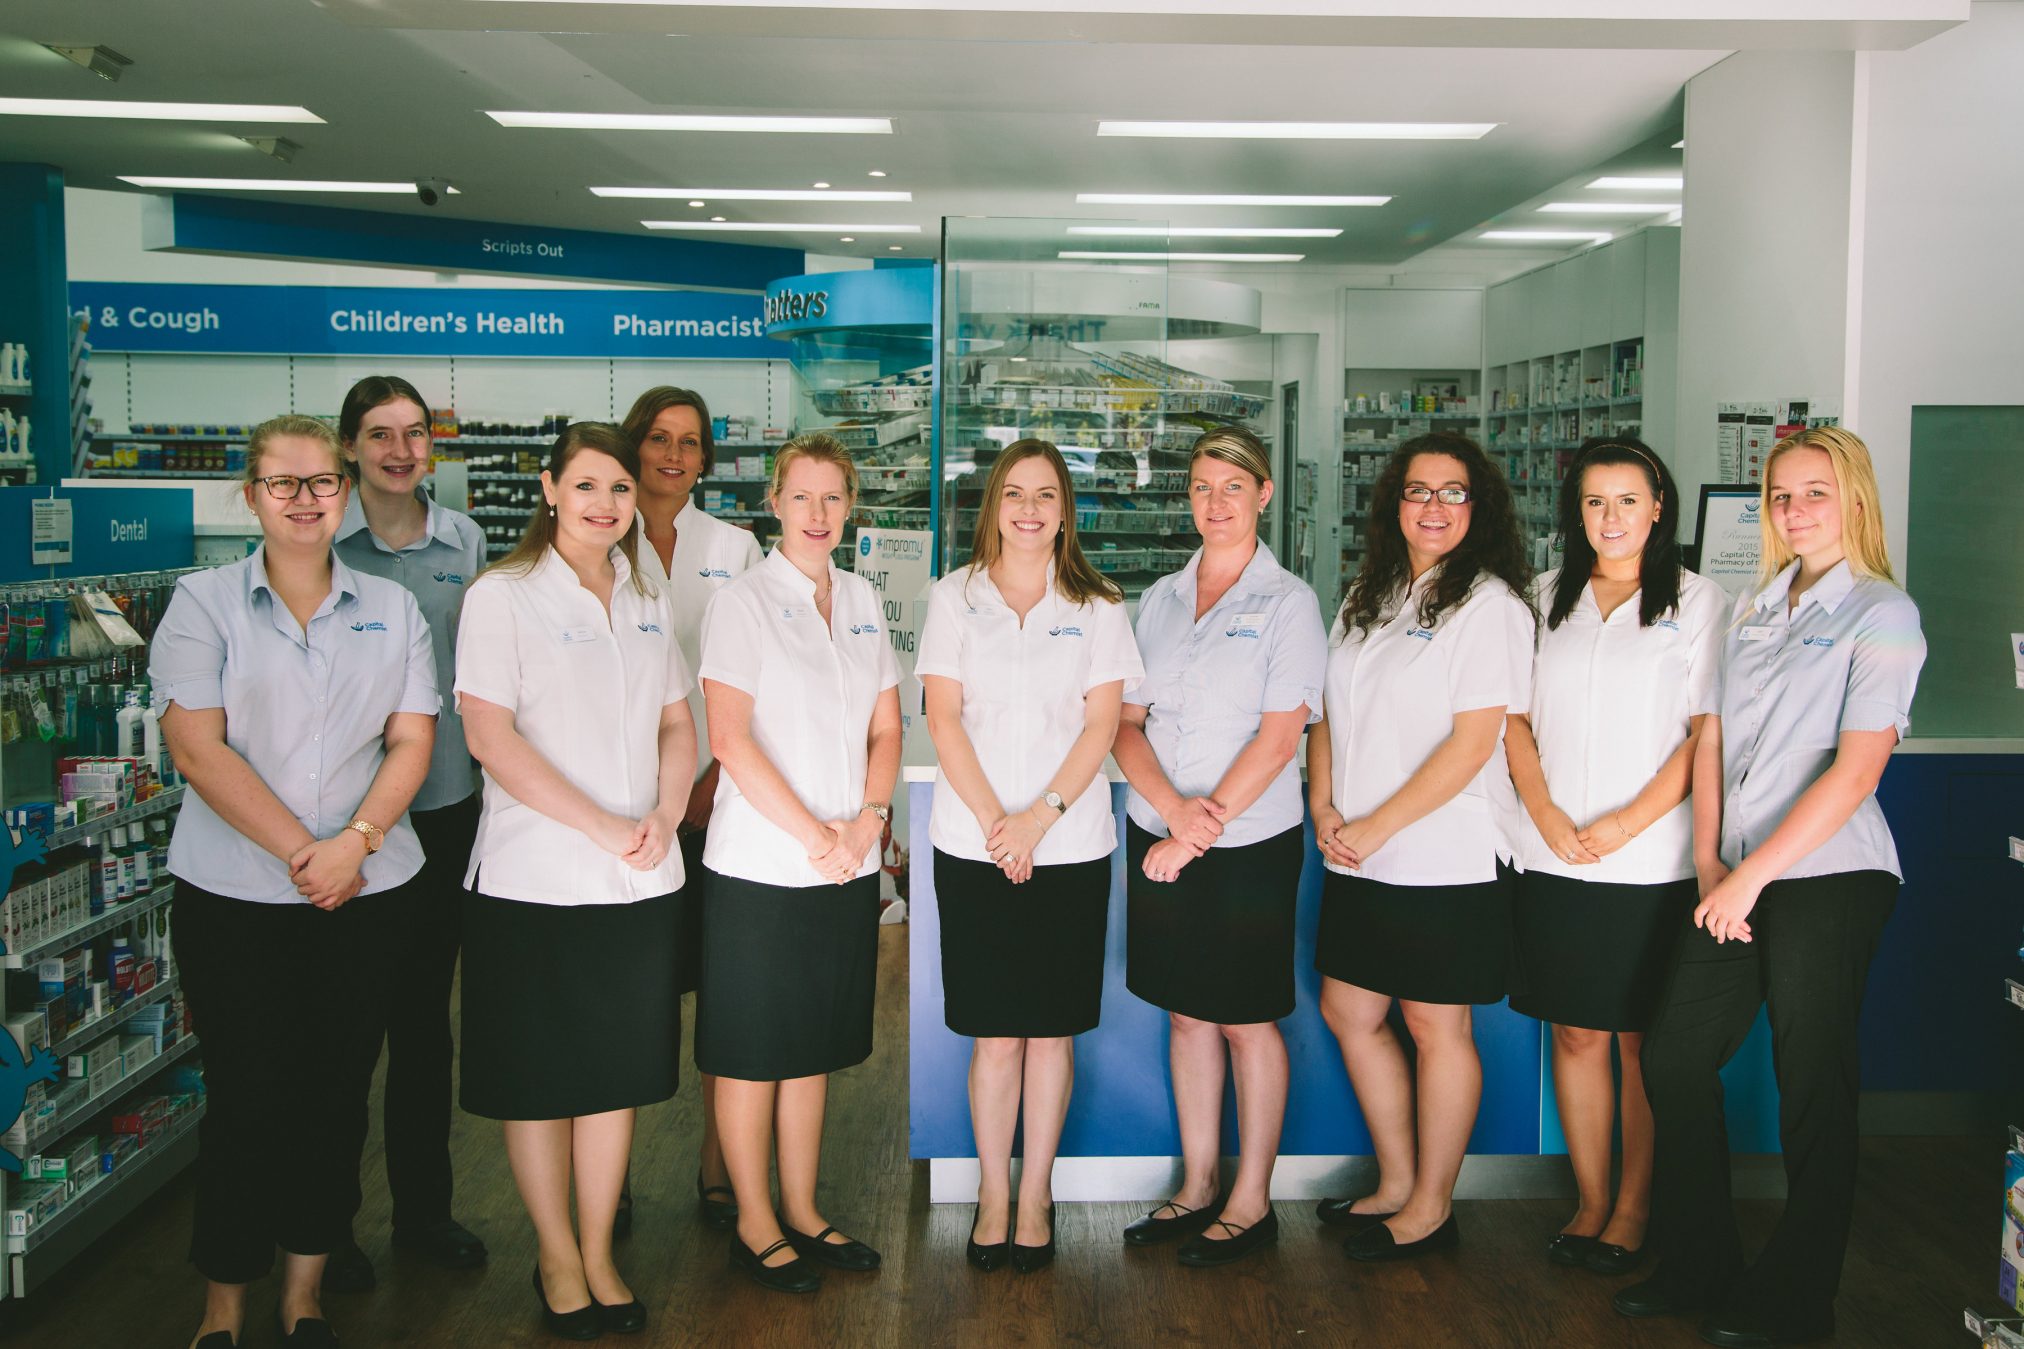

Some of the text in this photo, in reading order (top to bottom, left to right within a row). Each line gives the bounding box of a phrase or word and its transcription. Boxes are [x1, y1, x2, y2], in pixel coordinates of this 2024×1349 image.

[482, 238, 564, 257] Scripts Out
[764, 288, 829, 327] atters
[100, 306, 119, 327] &
[128, 306, 220, 333] Cough
[330, 309, 564, 334] Children's Health
[613, 314, 763, 337] Pharmacist
[110, 517, 147, 541] Dental
[1720, 551, 1745, 559] Capital
[1738, 543, 1758, 551] 2015
[1710, 558, 1755, 567] Pharmacy of
